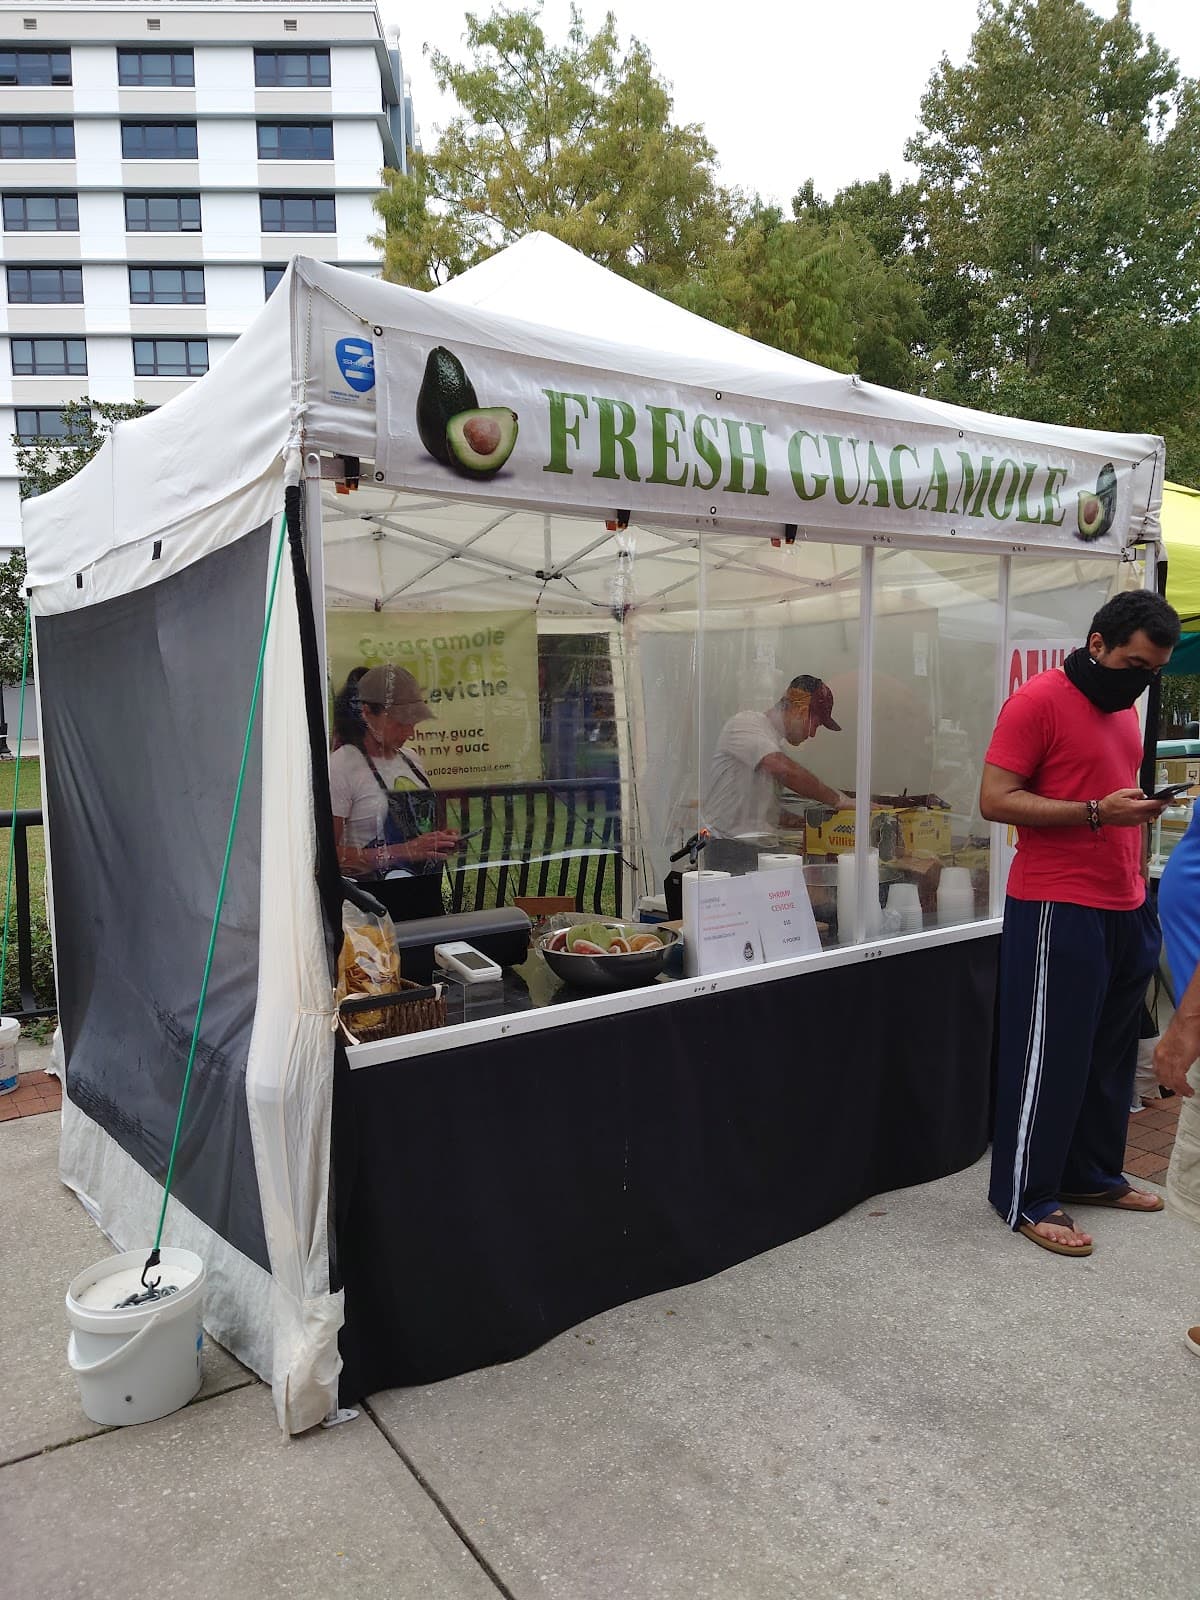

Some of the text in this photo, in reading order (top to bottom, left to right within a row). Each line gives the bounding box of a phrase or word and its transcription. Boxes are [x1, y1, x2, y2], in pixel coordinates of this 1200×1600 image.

[542, 388, 1069, 527] FRESH GUACAMOLE
[358, 626, 506, 659] Guacamole
[363, 650, 509, 690] lsas
[421, 679, 509, 705] eviche
[430, 746, 450, 757] my
[455, 743, 490, 756] guac
